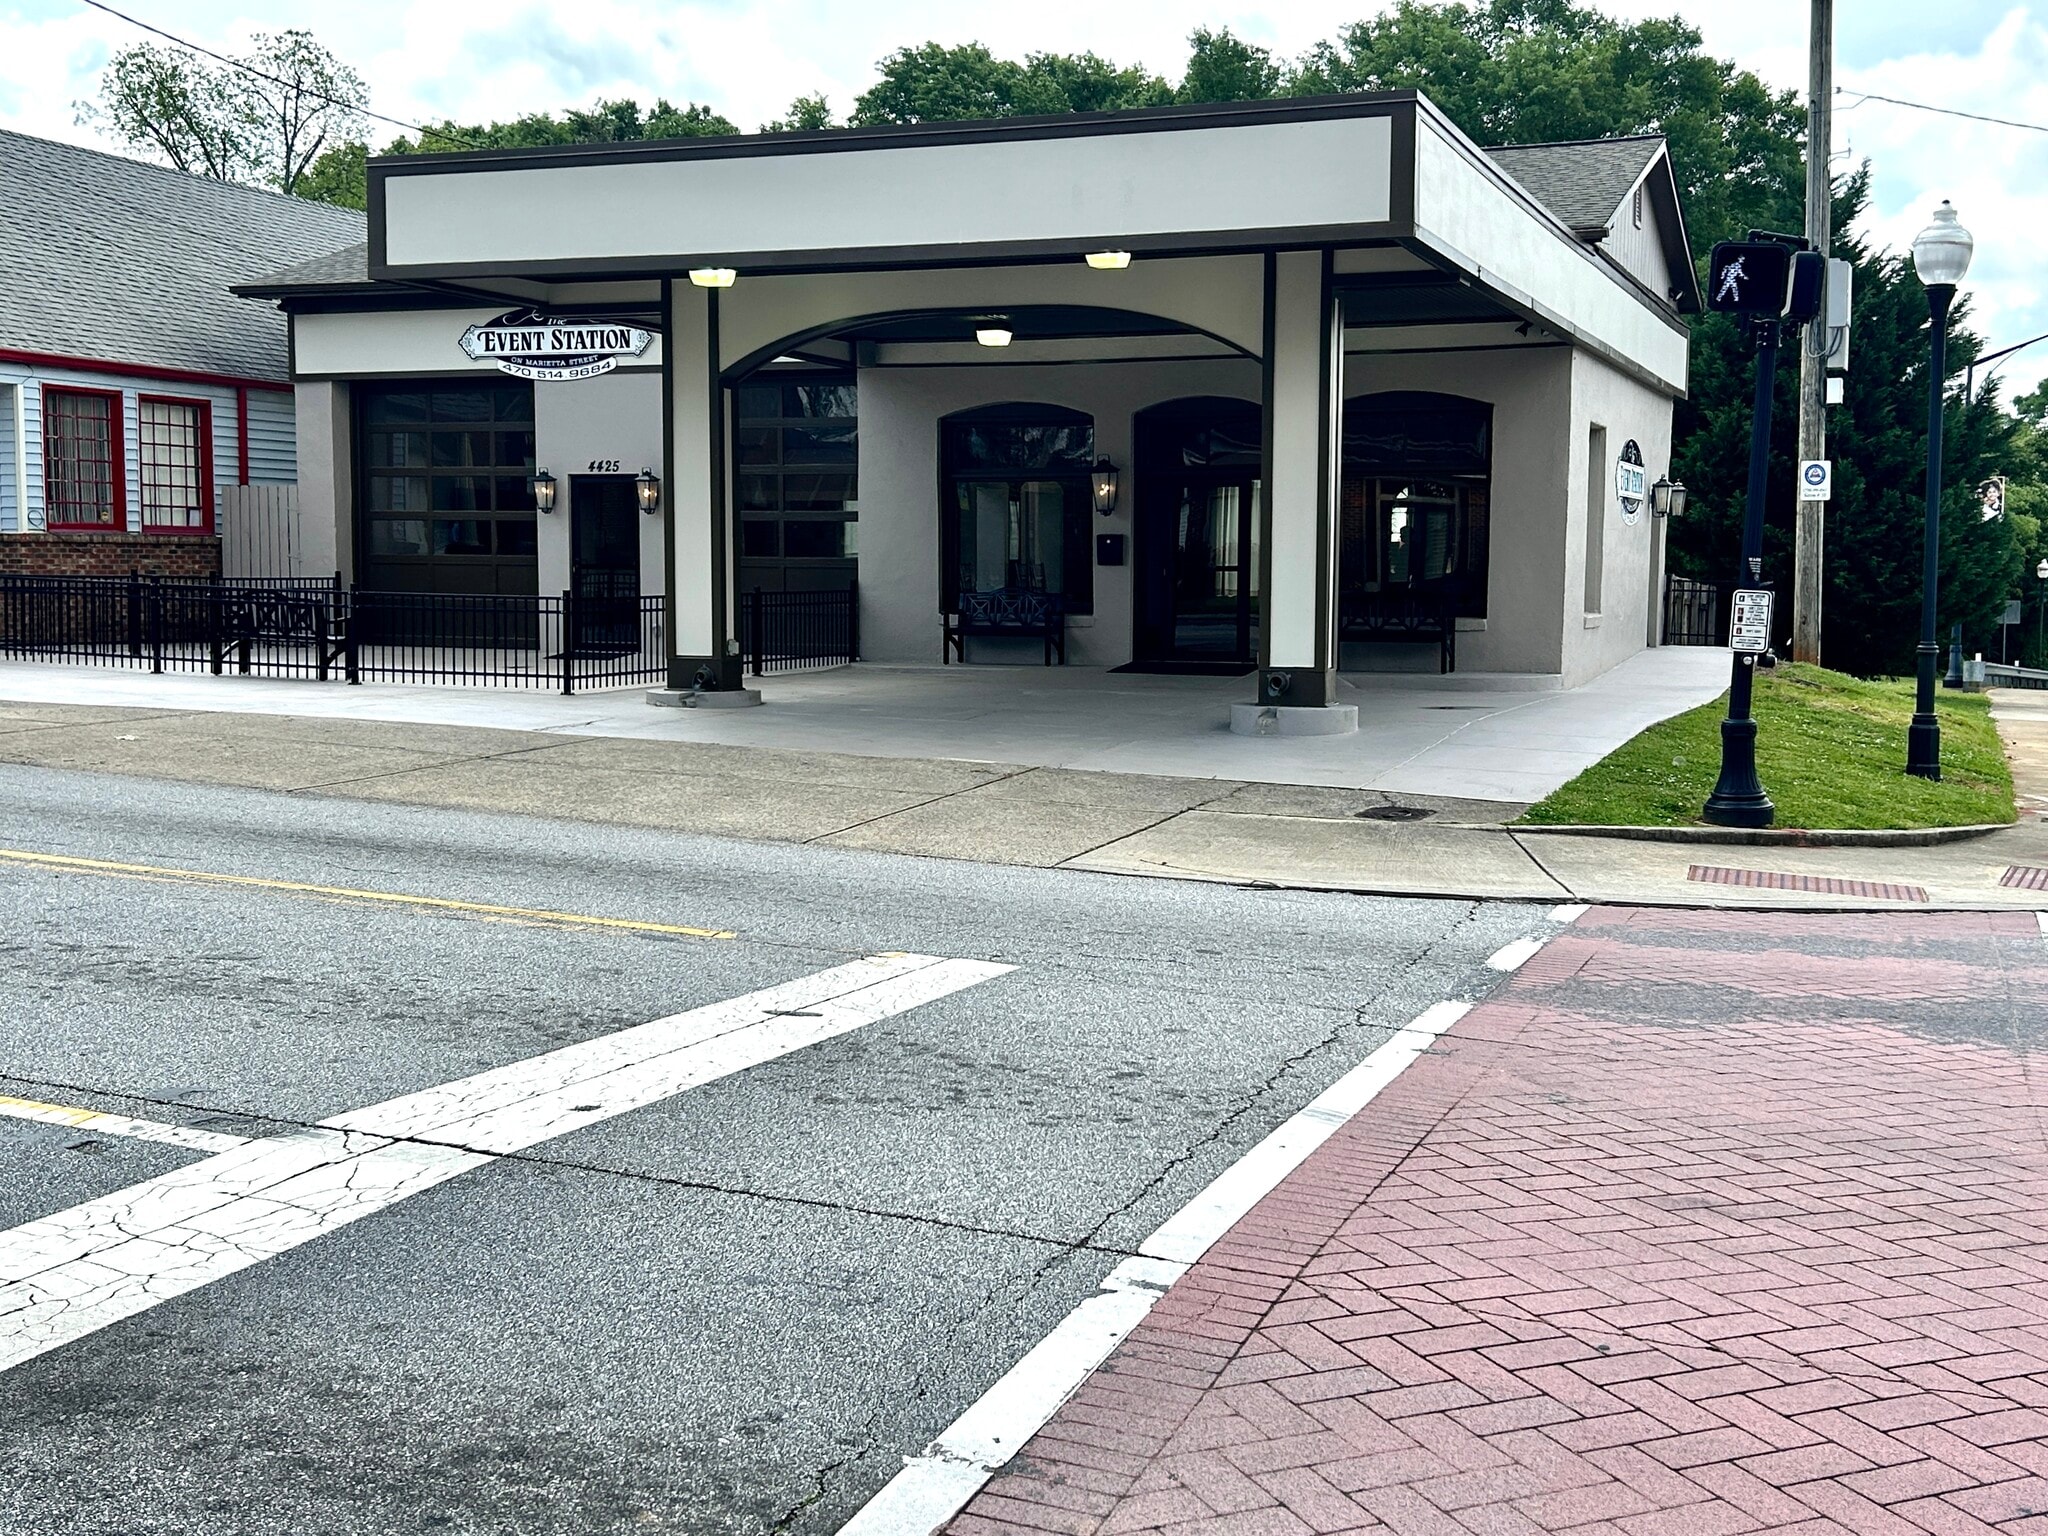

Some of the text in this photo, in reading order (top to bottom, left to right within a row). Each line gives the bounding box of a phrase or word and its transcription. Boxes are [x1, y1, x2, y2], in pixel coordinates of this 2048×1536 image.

[477, 329, 631, 352] EVENT STATION
[511, 355, 599, 366] ON MARIETTA STREET
[588, 460, 620, 472] 4425
